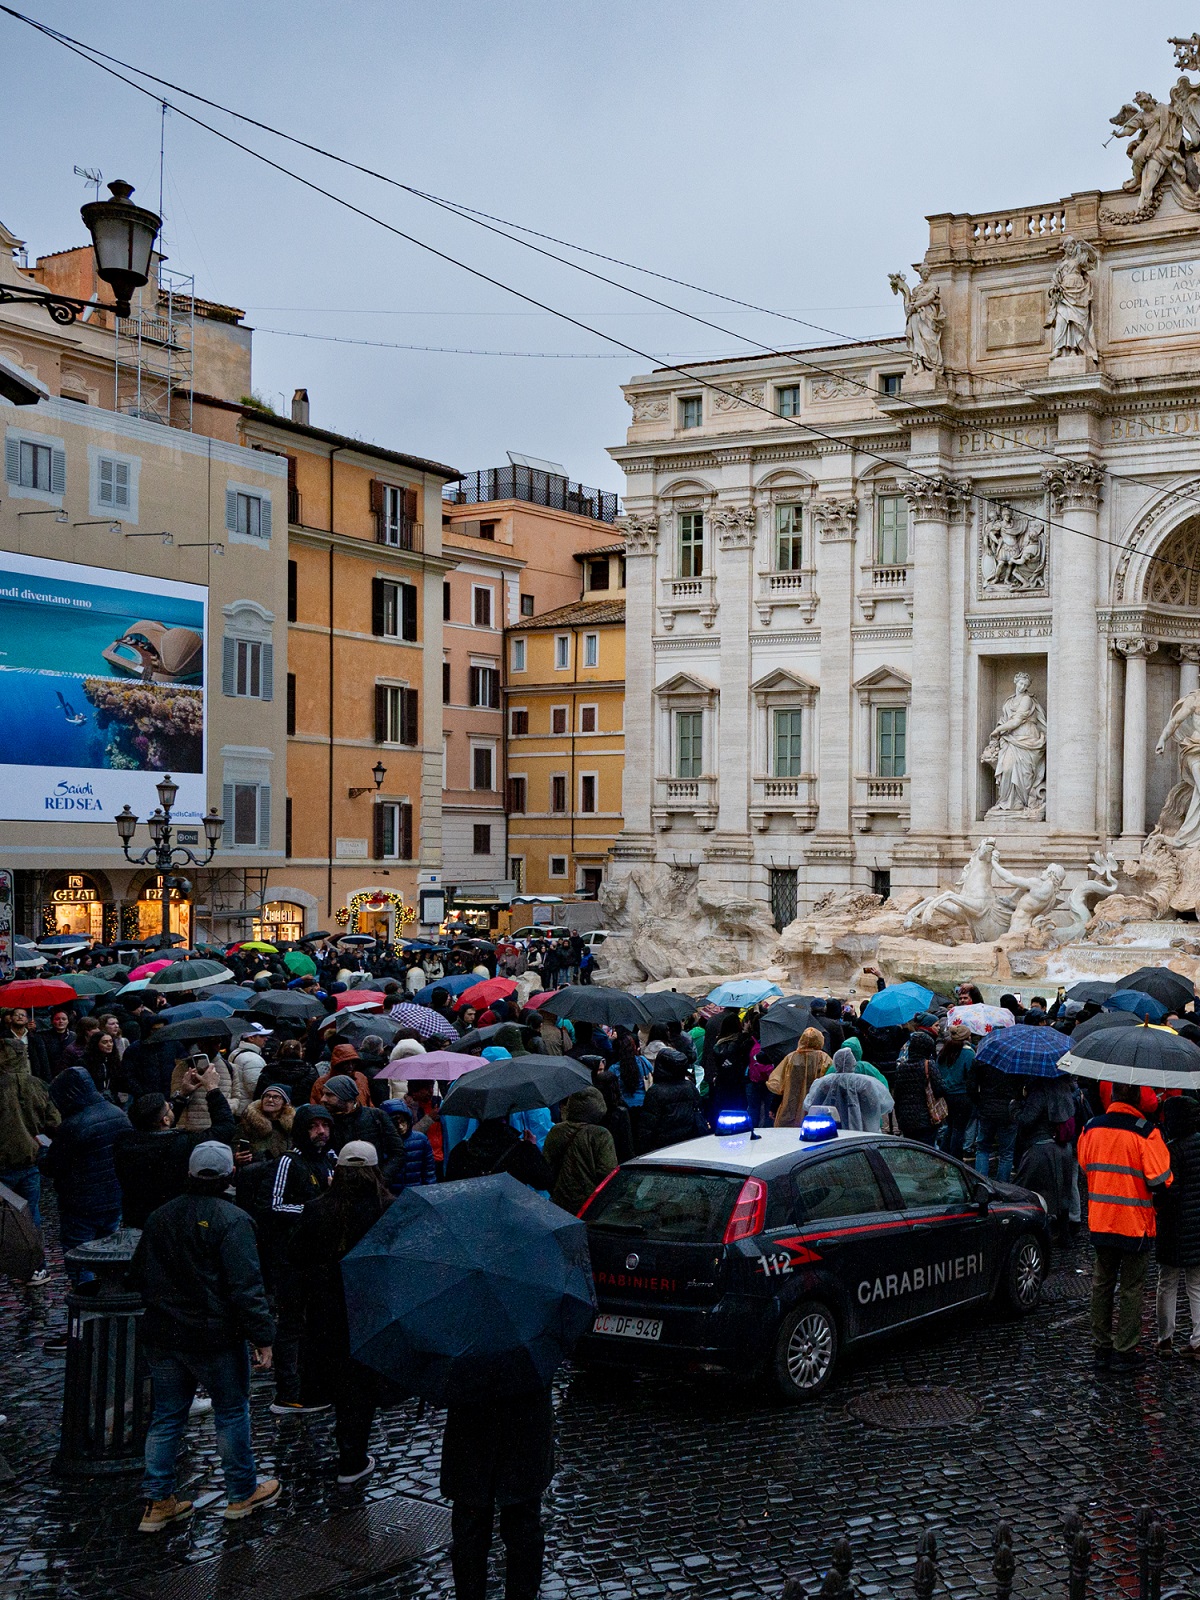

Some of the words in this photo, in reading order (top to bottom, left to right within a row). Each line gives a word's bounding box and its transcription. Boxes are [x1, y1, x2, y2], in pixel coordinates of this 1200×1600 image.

[1131, 263, 1194, 284] CLEMENS
[1119, 296, 1150, 310] COPIA
[1154, 295, 1166, 306] ET
[1145, 307, 1180, 320] CVLTV
[1123, 322, 1154, 335] ANNO
[1158, 318, 1198, 331] DOMINI
[0, 587, 18, 598] ndi
[20, 590, 70, 605] diventano
[72, 598, 92, 608] uno
[45, 797, 74, 810] RED
[76, 798, 103, 811] SEA
[756, 1252, 794, 1277] 112
[592, 1272, 677, 1293] ARABINIERI
[858, 1252, 985, 1305] CARABINIERI
[596, 1315, 611, 1331] CC
[636, 1321, 660, 1338] 948
